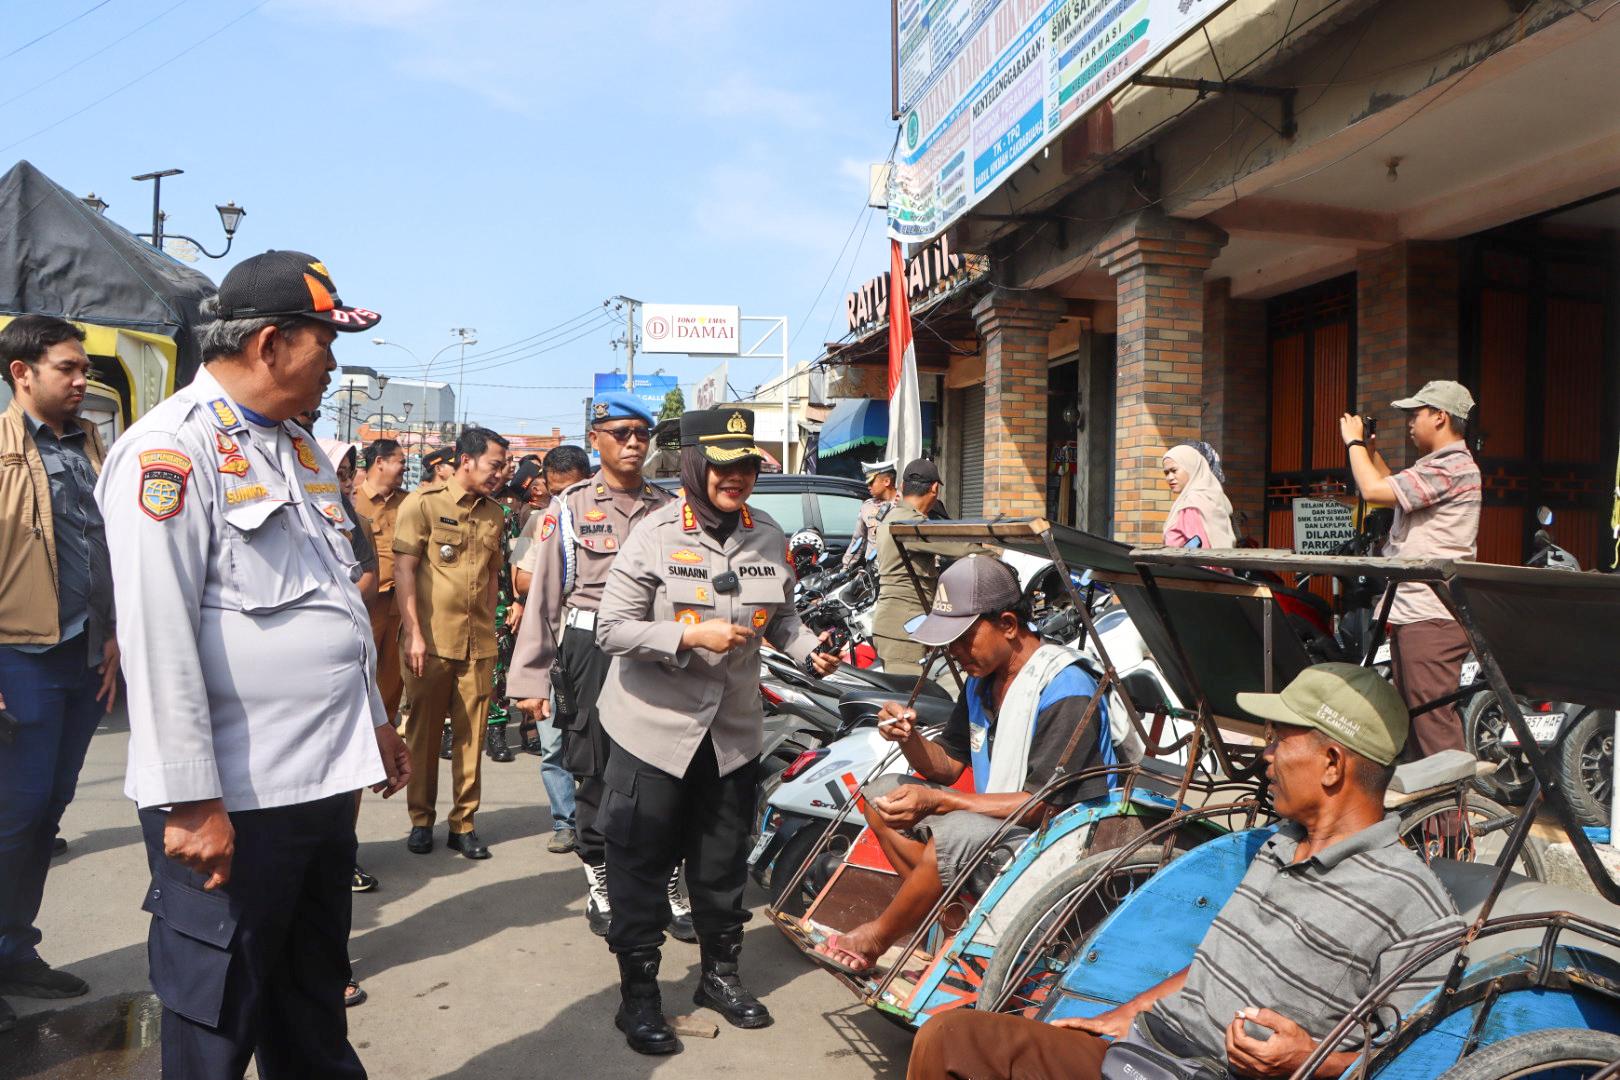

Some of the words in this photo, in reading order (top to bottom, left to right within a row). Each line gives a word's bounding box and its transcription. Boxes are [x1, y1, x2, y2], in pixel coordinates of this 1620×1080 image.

[1051, 12, 1071, 42] SMK
[1080, 22, 1122, 68] FARMASI
[847, 272, 888, 332] RATU
[677, 325, 734, 338] DAMAI
[668, 565, 709, 579] SUMARNI
[738, 566, 776, 577] POLRI
